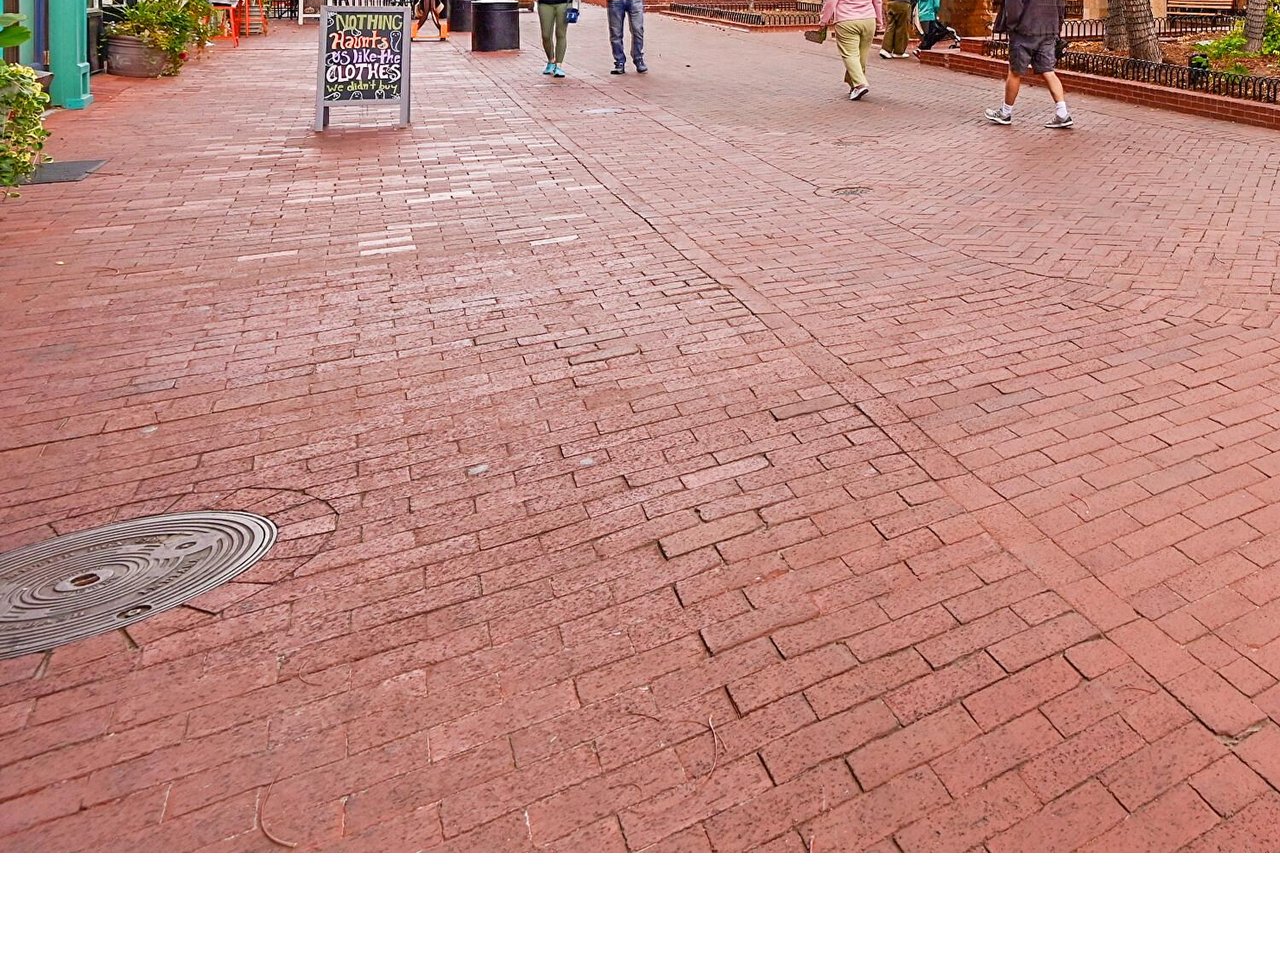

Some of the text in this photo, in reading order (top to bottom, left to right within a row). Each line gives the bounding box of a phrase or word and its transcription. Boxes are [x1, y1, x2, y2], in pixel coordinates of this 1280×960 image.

[336, 14, 402, 30] NOTHING
[329, 30, 389, 50] Haunts
[326, 63, 401, 83] CLOTHES
[347, 80, 377, 92] didn't
[379, 81, 398, 94] buy
